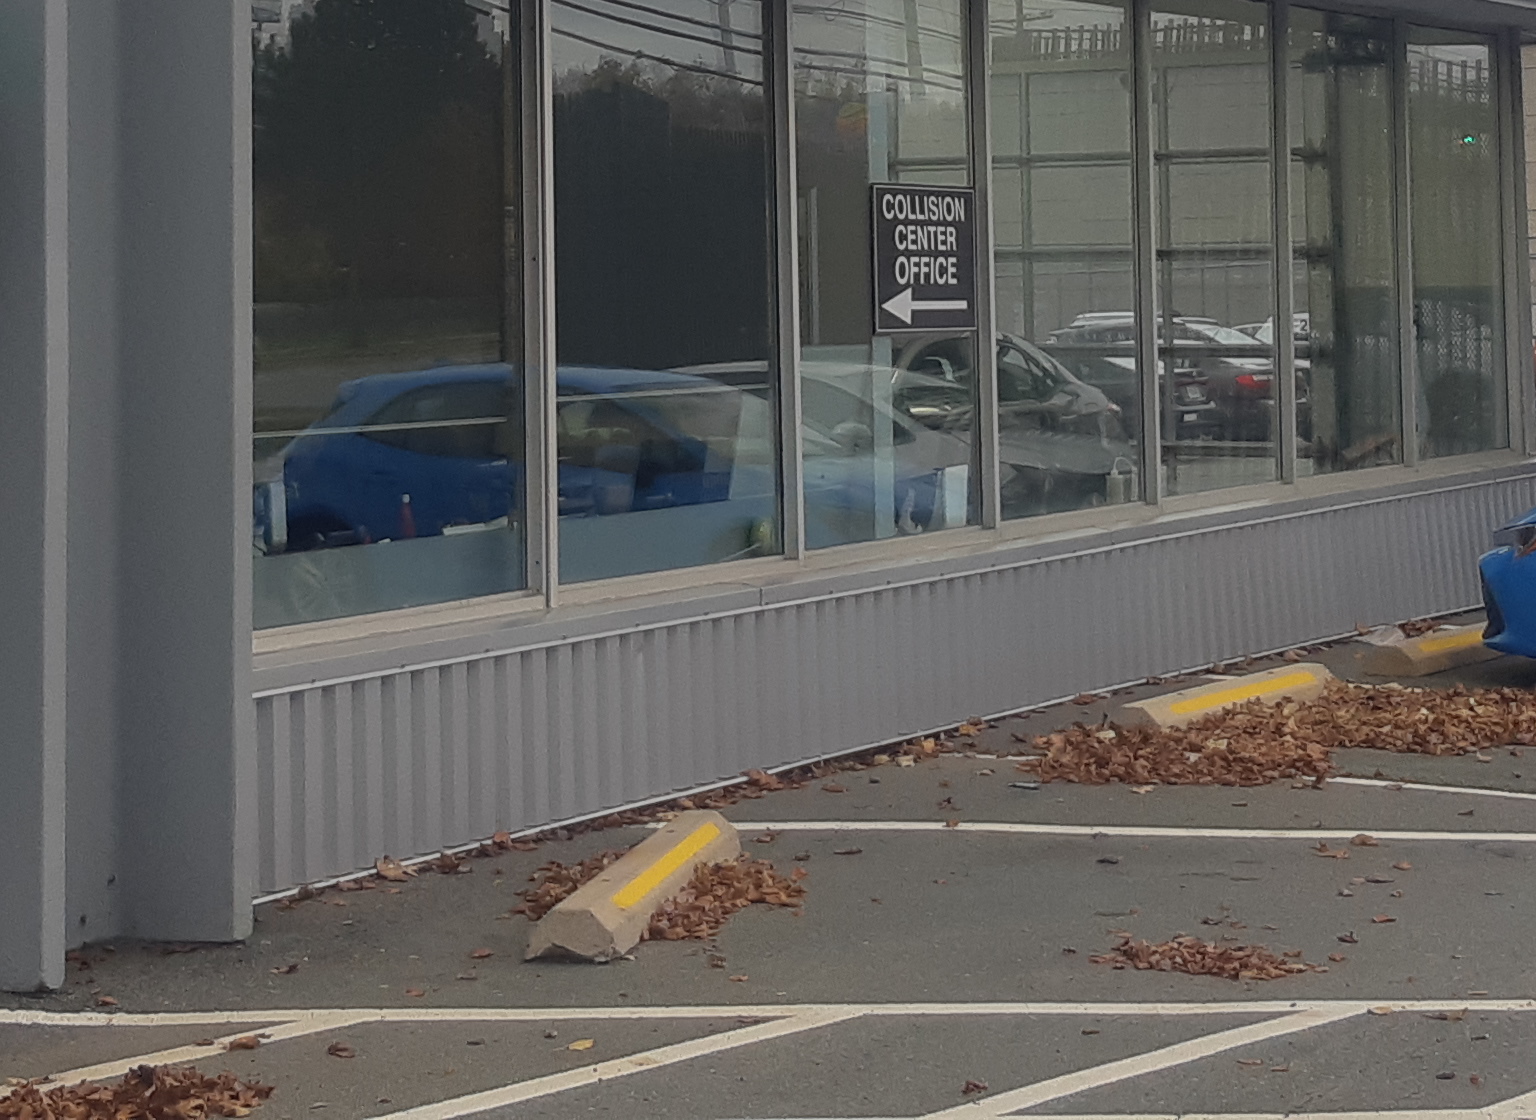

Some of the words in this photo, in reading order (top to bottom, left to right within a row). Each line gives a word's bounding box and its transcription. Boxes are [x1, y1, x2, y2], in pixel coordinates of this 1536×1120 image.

[882, 193, 965, 222] COLLISION
[894, 224, 957, 251] CENTER
[894, 255, 958, 285] OFFICE
